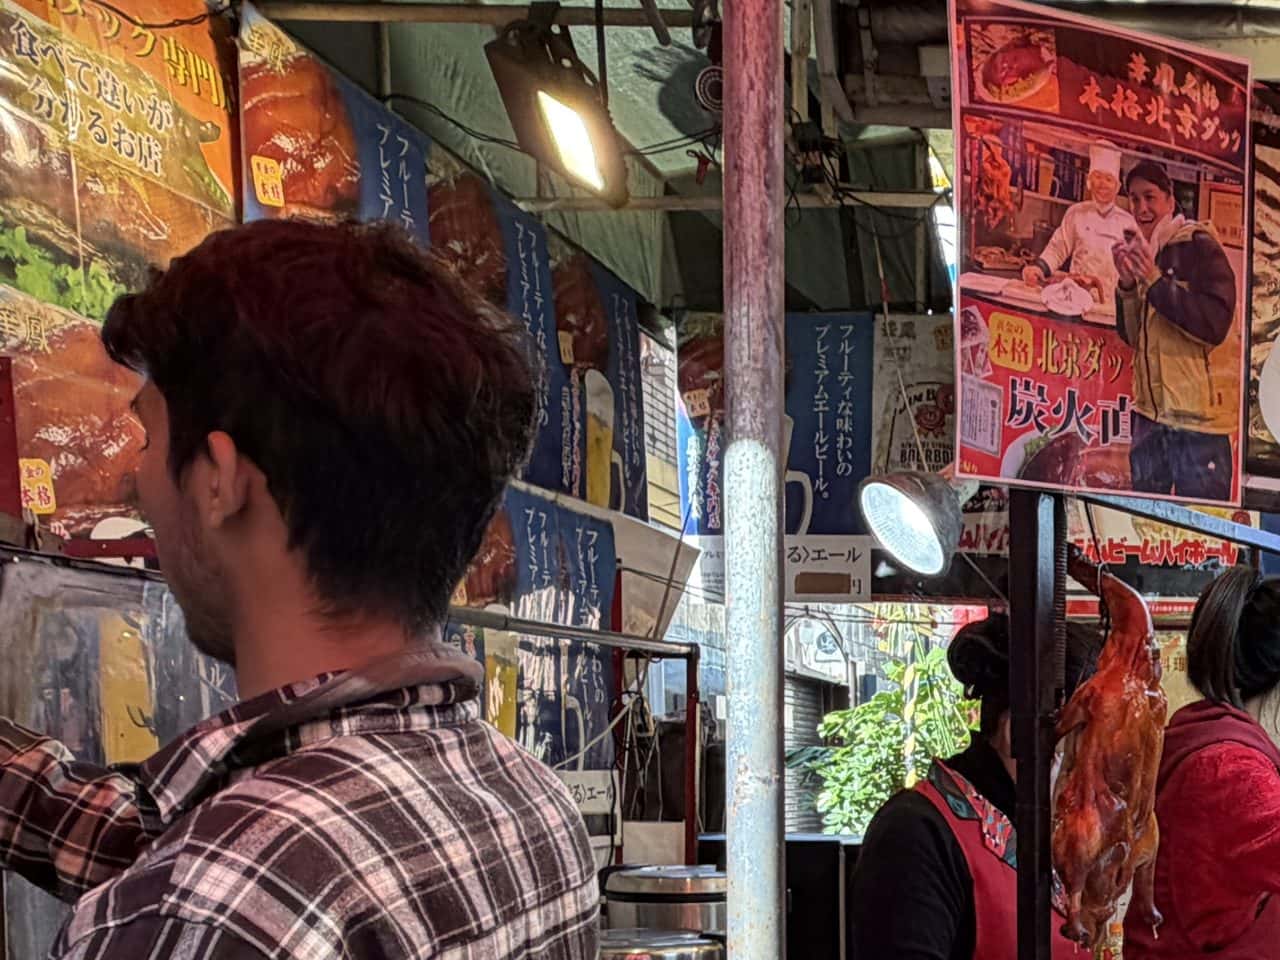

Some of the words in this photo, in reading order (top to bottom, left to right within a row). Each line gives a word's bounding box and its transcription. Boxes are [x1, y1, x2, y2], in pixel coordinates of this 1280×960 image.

[11, 18, 174, 131] 食べて違いが
[28, 77, 163, 175] 分かるお店
[836, 324, 855, 477] フルーティな味わいの
[1036, 328, 1129, 383] 北京ダッ
[813, 323, 833, 499] プレミアムエールビール。
[957, 522, 1010, 552] ムハイ
